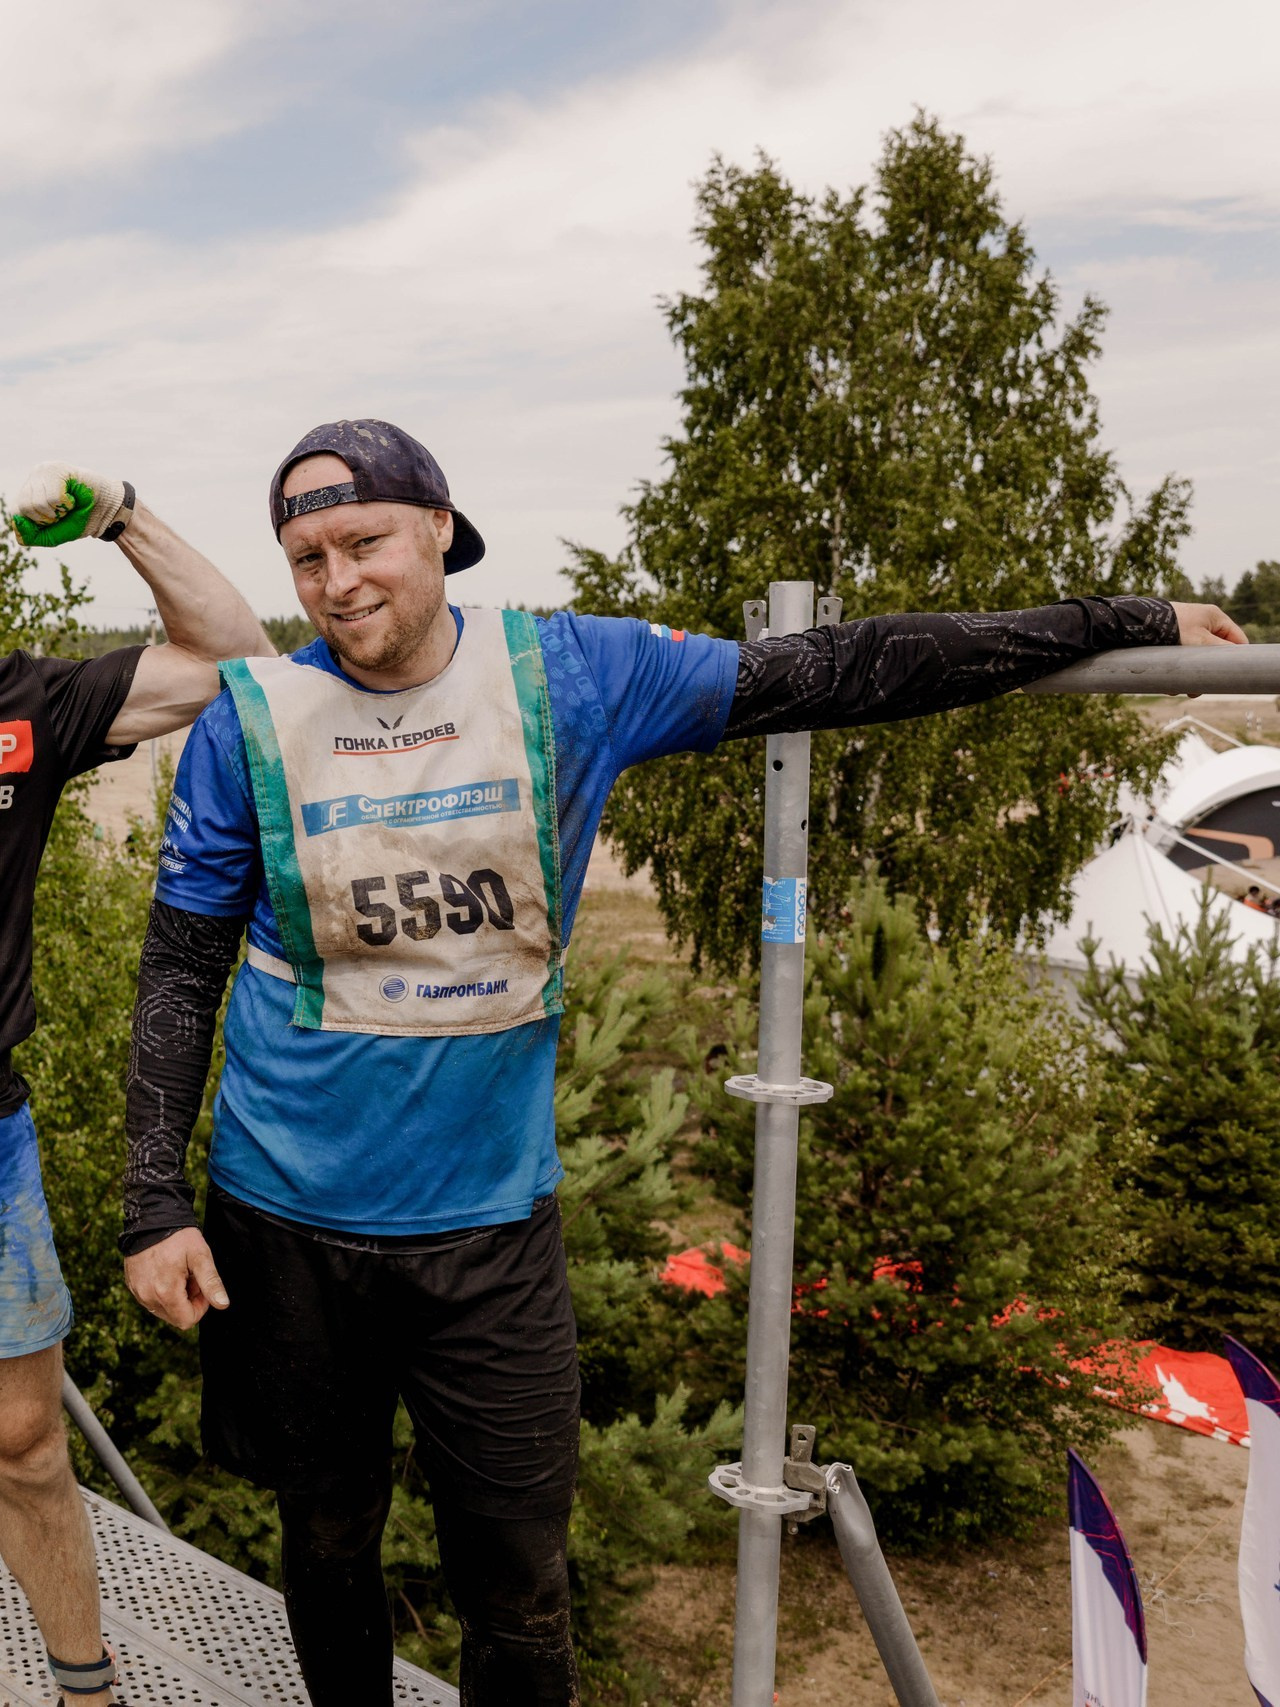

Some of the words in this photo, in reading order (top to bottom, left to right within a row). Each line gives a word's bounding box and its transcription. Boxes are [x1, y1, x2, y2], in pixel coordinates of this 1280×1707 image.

[334, 736, 389, 752] ГОНКА
[392, 722, 456, 749] ГЕРОЕВ
[351, 868, 516, 946] 5590
[416, 978, 509, 1000] ГАЗПРОМБАНК
